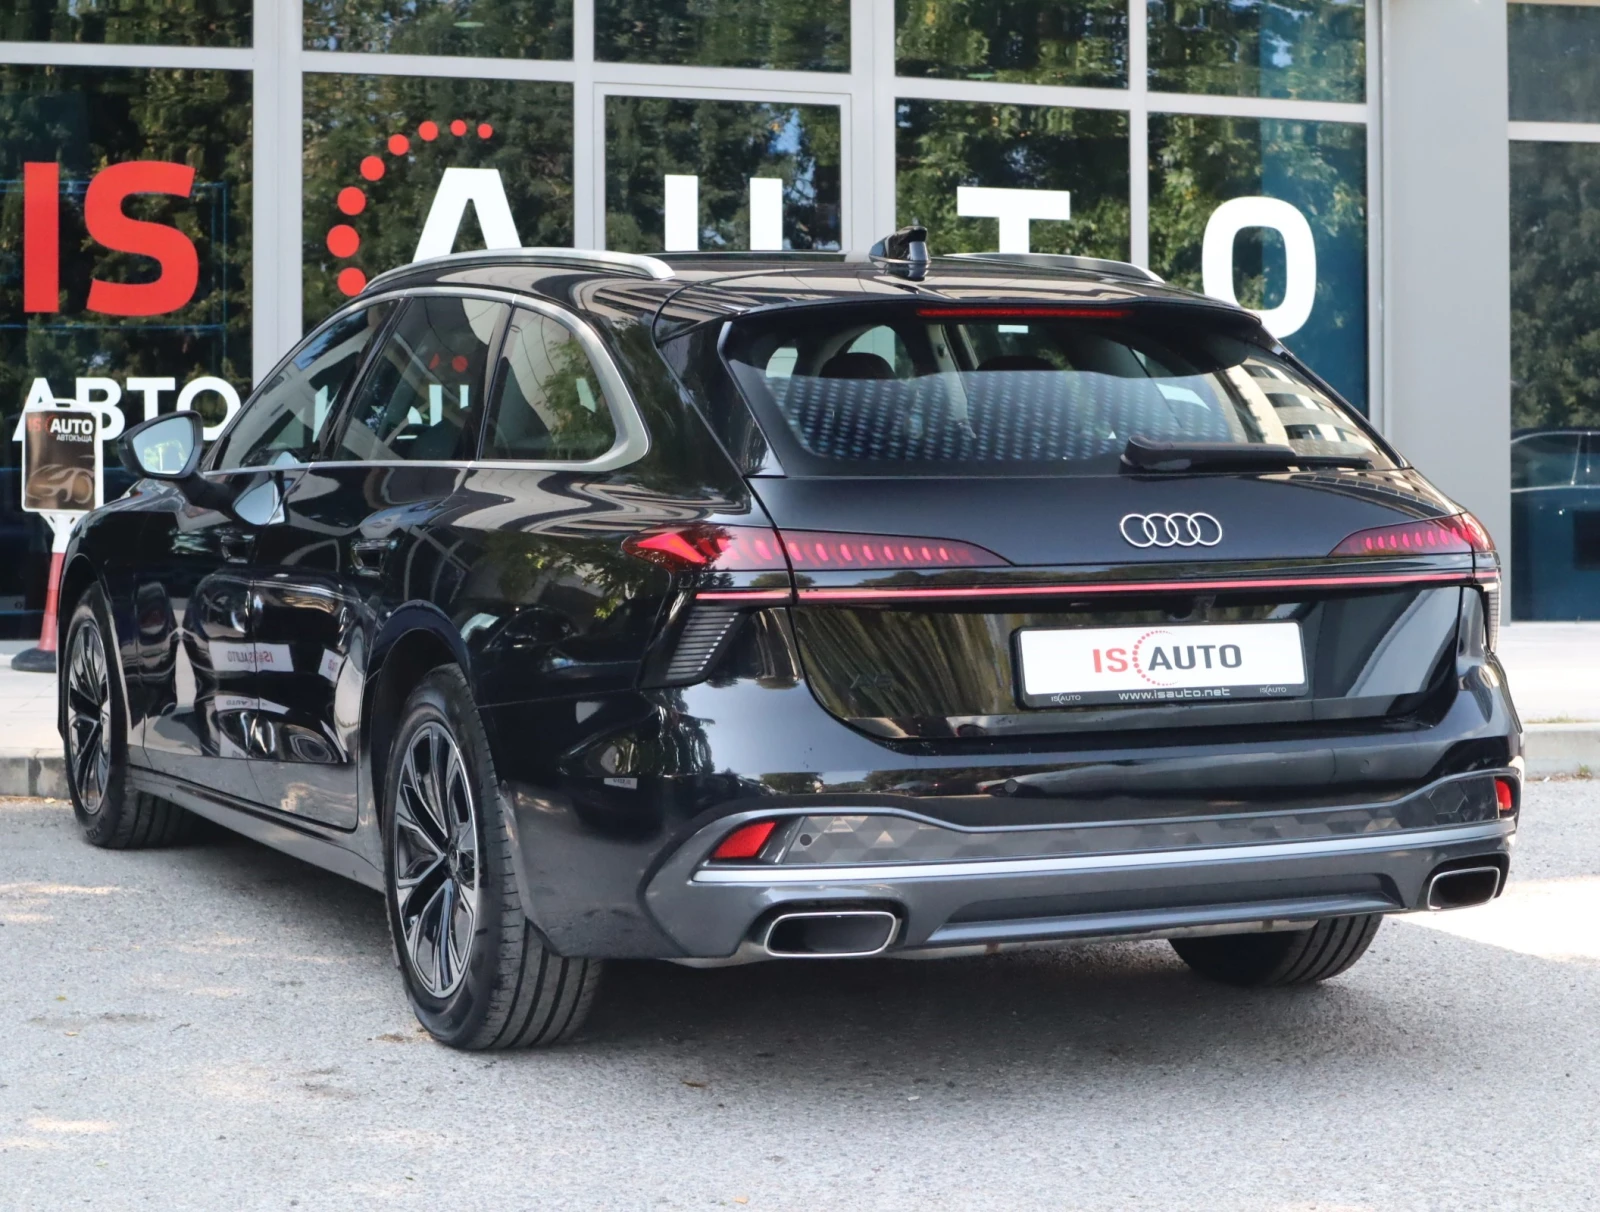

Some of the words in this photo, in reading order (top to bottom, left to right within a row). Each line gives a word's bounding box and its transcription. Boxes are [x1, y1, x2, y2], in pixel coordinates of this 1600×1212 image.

[23, 160, 199, 317] IS
[50, 418, 94, 434] AUTO
[1092, 648, 1129, 673] IS
[1148, 644, 1243, 671] AUTO
[1118, 687, 1231, 702] www.isauto.net
